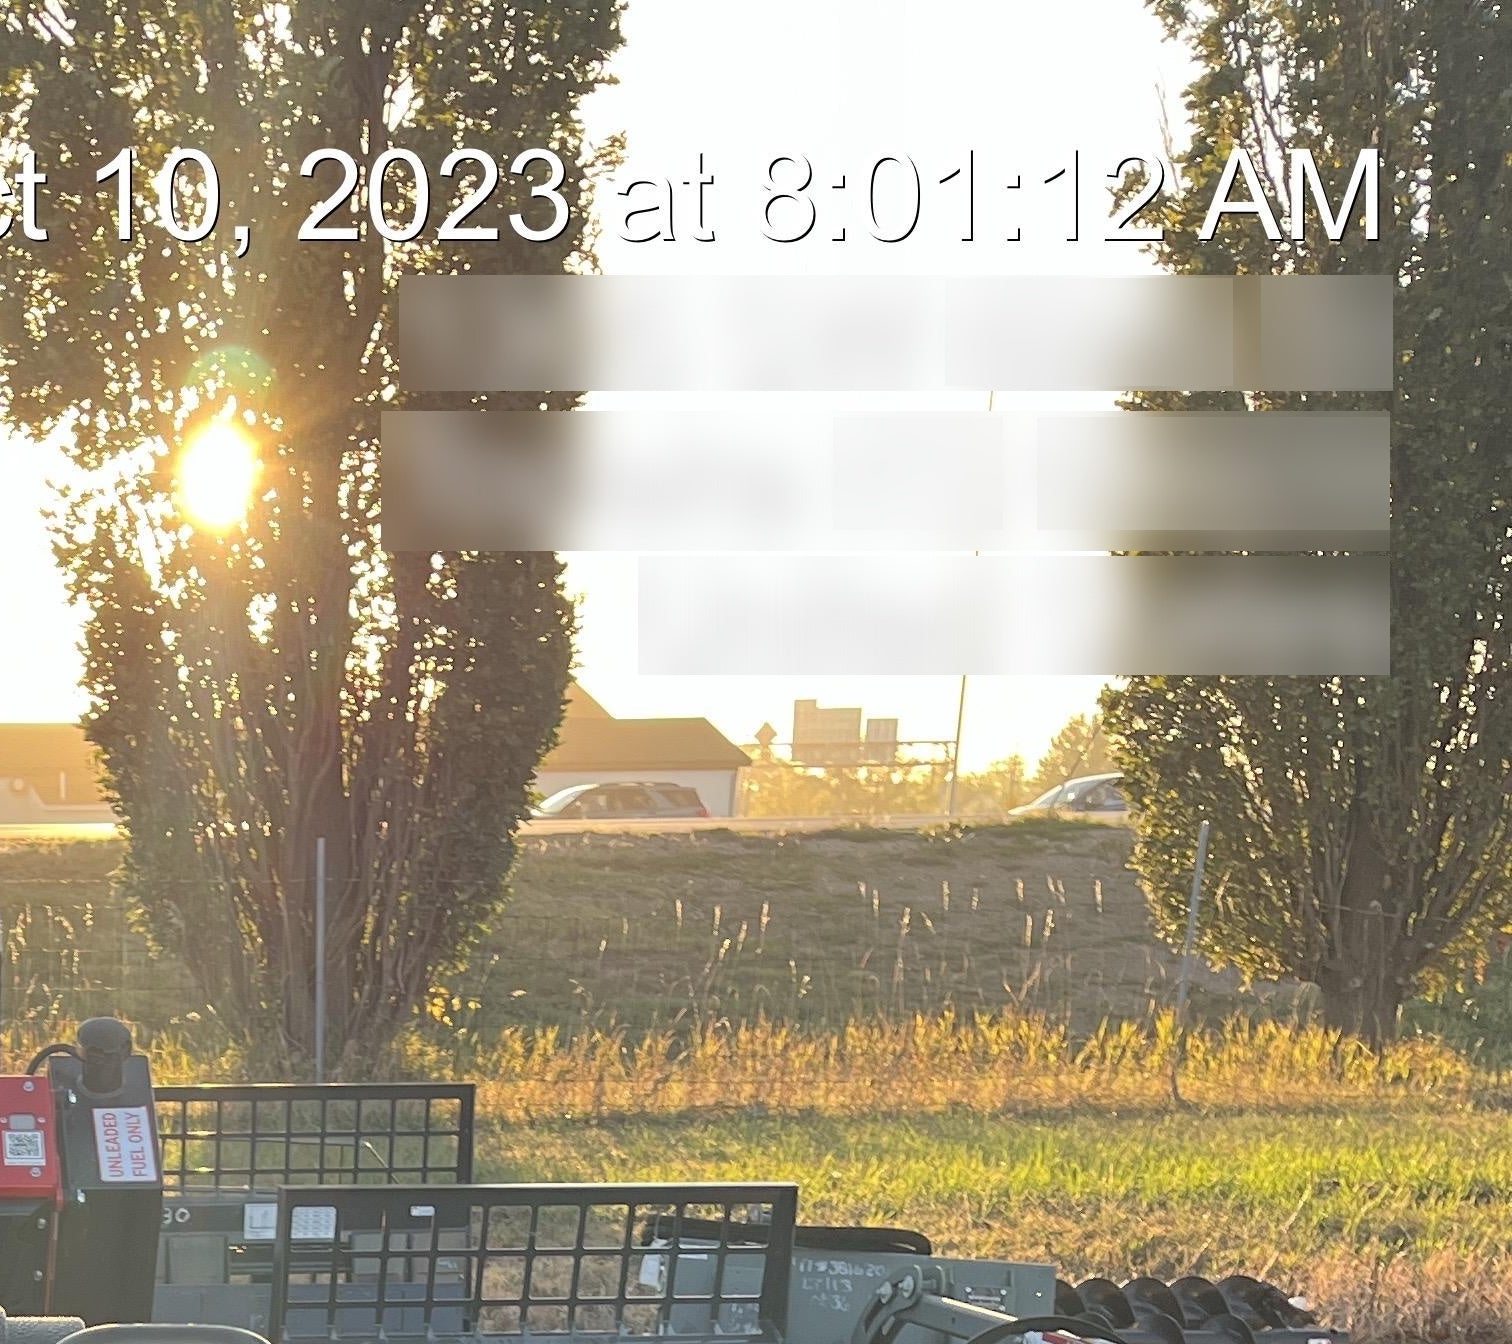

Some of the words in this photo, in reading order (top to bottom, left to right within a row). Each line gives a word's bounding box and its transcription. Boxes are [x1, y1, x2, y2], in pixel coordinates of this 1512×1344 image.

[124, 1112, 144, 1143] ONLY
[102, 1113, 124, 1178] UNLEADED
[130, 1148, 148, 1178] FUEL
